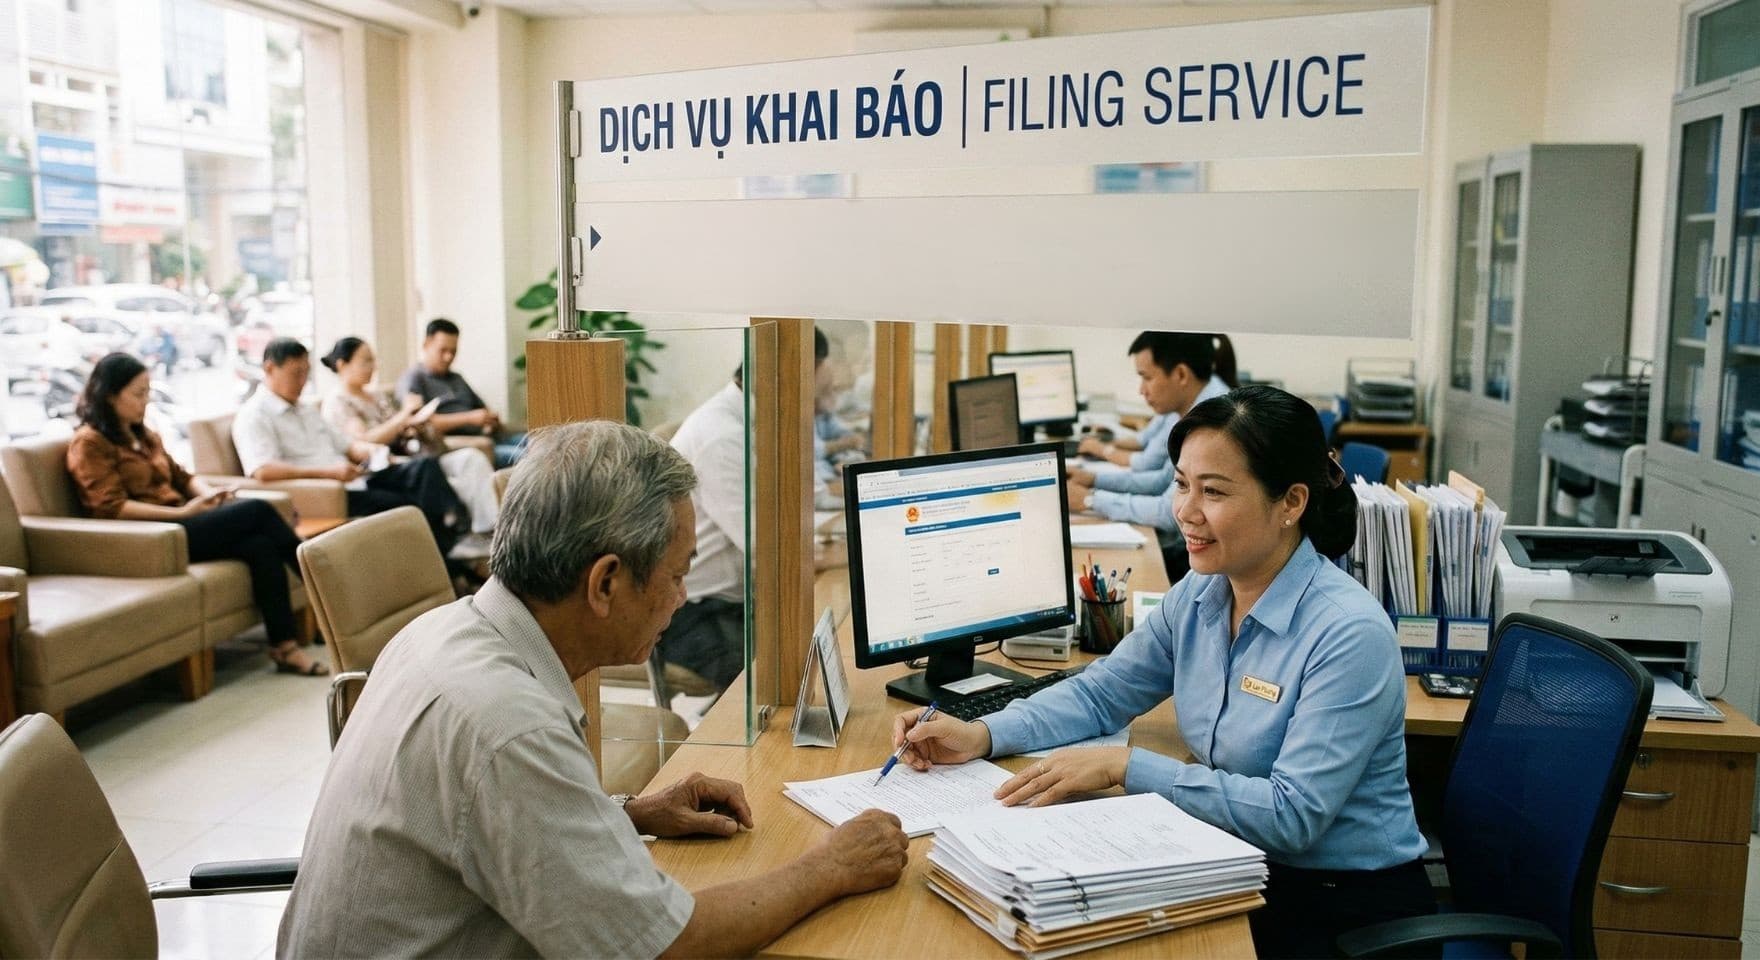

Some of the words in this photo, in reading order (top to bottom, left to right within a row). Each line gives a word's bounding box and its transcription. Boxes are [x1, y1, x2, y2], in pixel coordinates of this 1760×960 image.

[600, 102, 674, 163] DỊCH
[685, 97, 731, 159] VỤ
[746, 88, 838, 144] KHAI
[855, 68, 943, 138] BÁO
[983, 70, 1124, 132] FILING
[1143, 53, 1366, 126] SERVICE
